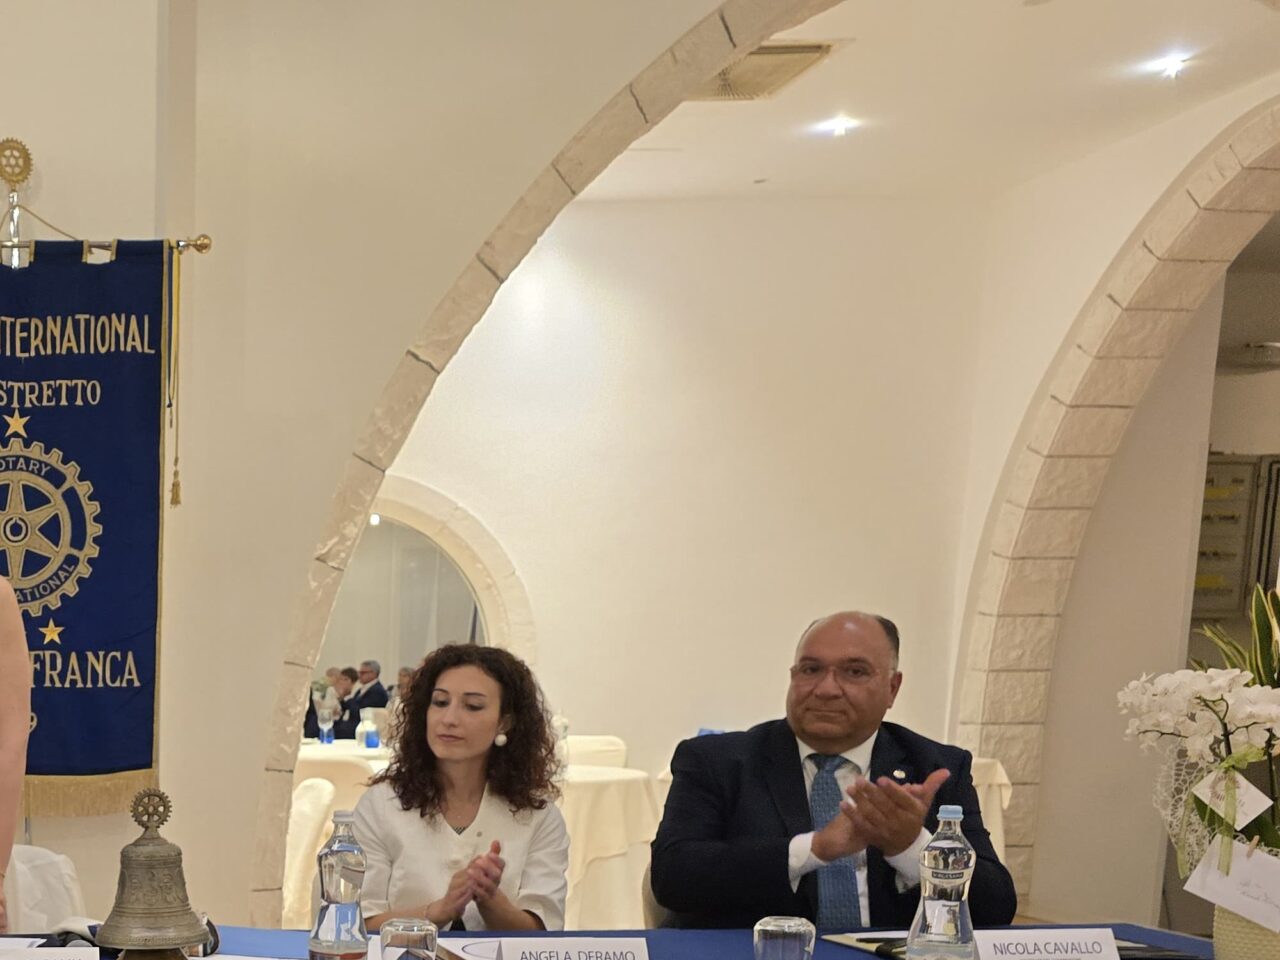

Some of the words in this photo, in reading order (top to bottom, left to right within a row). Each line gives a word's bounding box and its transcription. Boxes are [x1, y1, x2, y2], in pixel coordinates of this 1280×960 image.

[15, 564, 75, 602] ATIONAL
[29, 650, 141, 688] FRANCA
[993, 942, 1042, 956] NICOLA
[1043, 941, 1103, 955] CAVALLO
